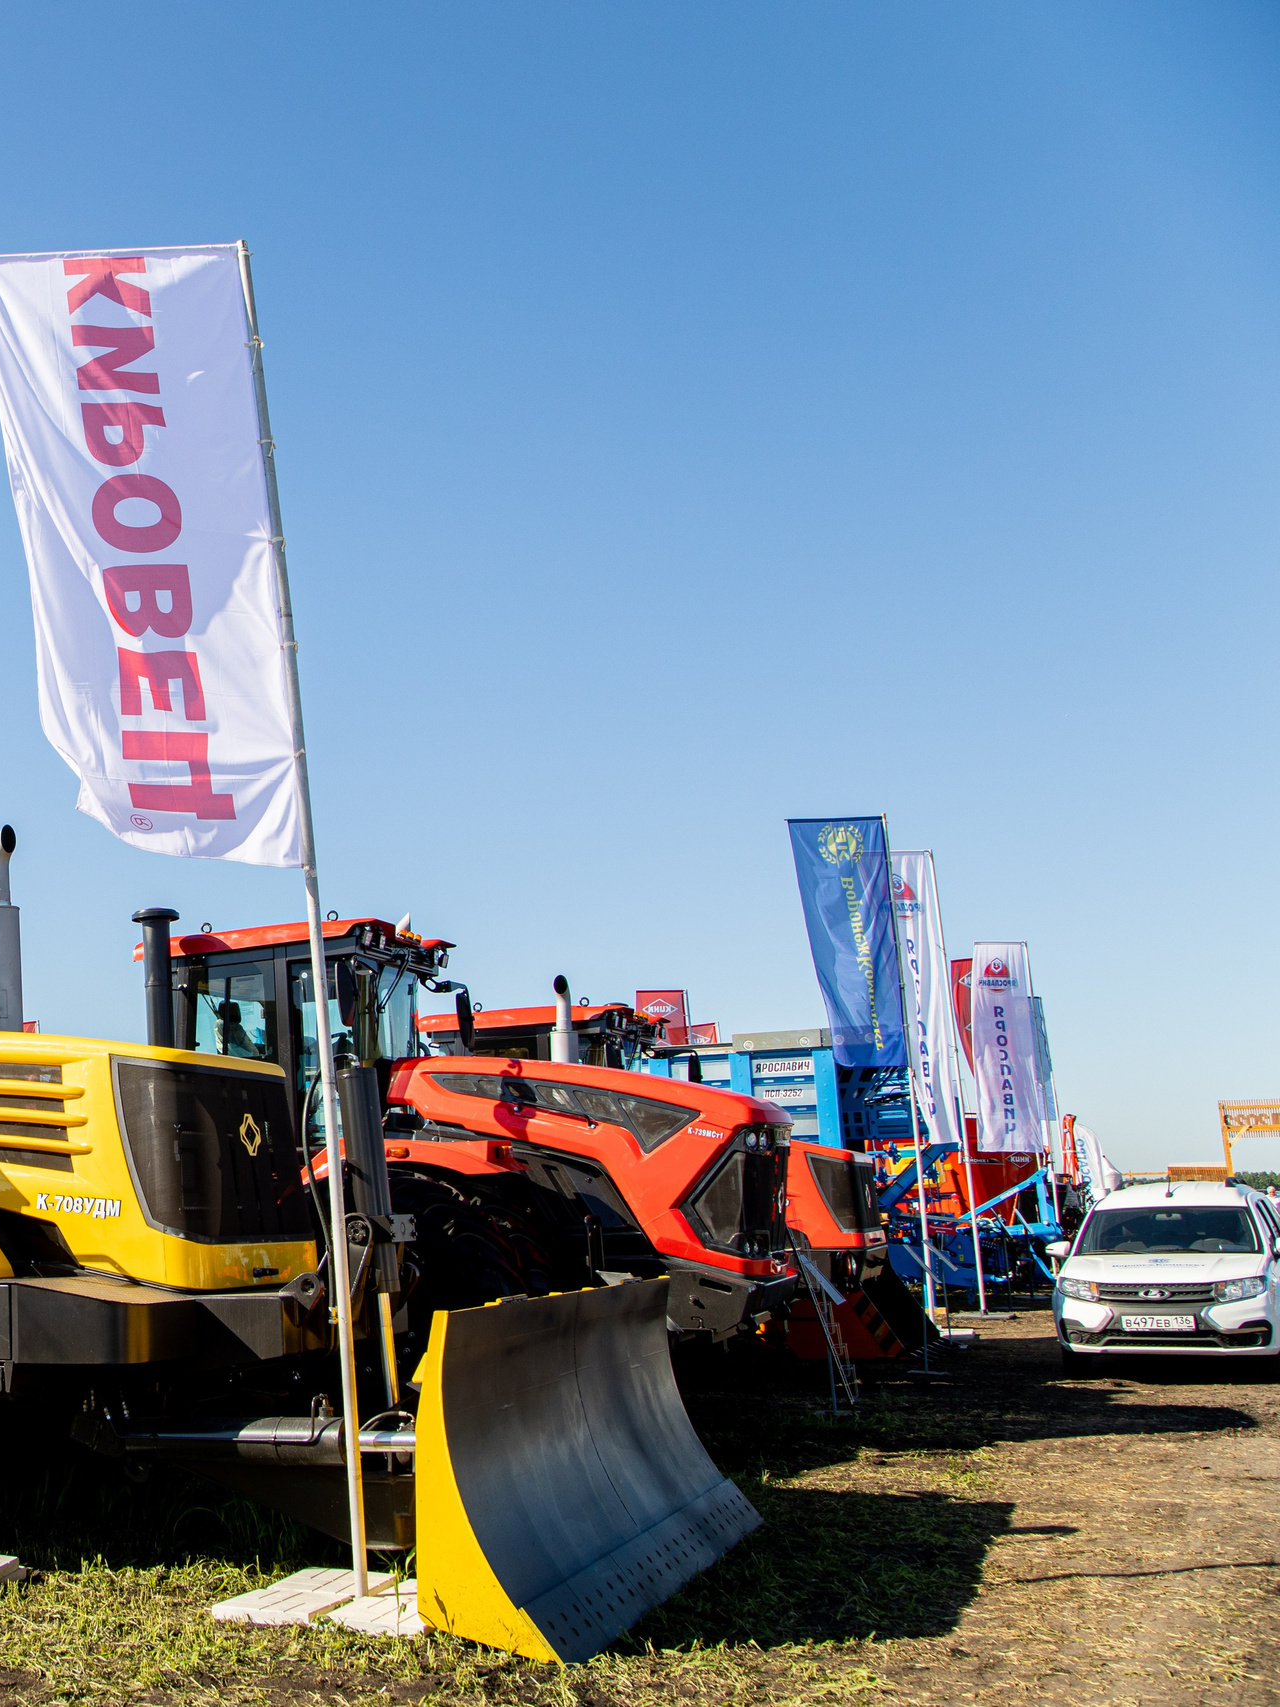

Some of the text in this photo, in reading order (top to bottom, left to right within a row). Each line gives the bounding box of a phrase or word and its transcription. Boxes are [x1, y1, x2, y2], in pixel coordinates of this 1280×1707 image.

[755, 1061, 810, 1073] ЯРОСЛАВИЧ
[764, 1089, 803, 1098] ПСП-3252
[36, 1193, 121, 1219] К-708УДМ
[1173, 1316, 1192, 1325] 136
